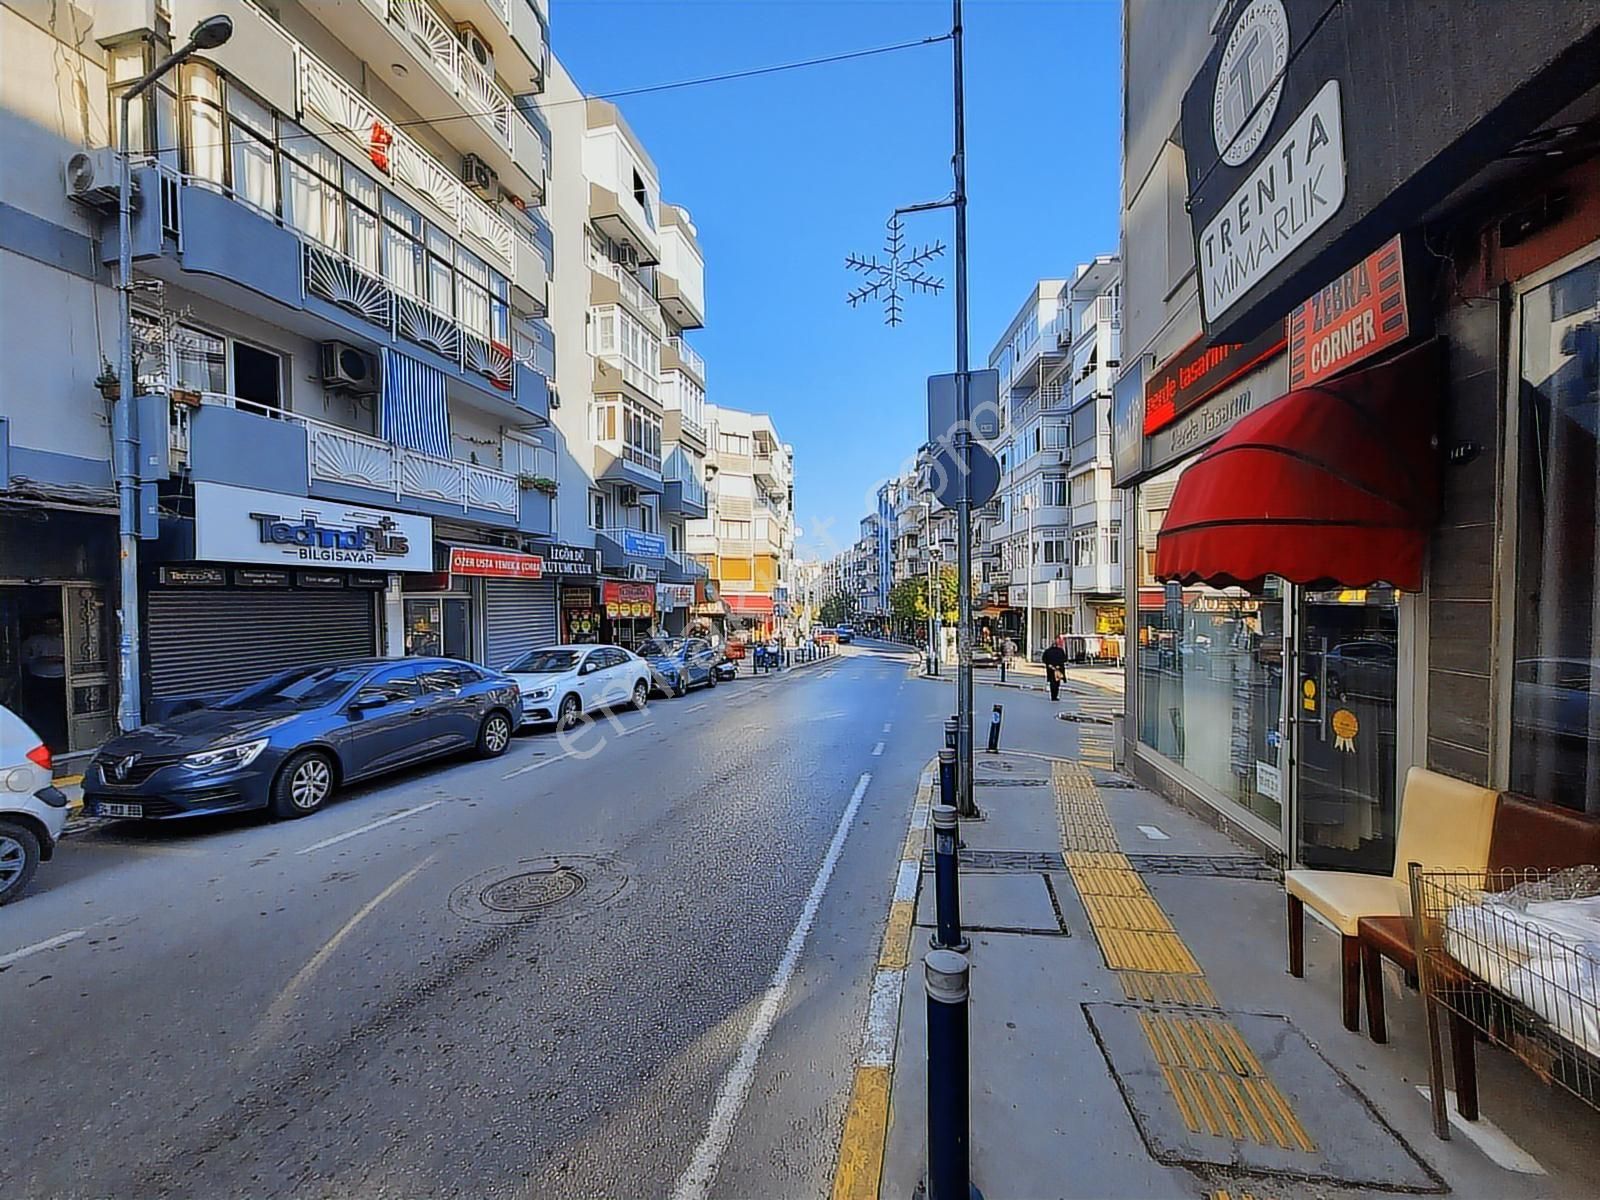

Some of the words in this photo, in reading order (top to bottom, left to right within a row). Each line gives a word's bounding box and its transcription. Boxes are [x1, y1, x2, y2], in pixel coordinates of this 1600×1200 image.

[1205, 112, 1330, 268] TRENTA
[1213, 163, 1328, 308] MİMARLIK
[1311, 259, 1373, 335] ZEBRA
[1310, 308, 1376, 374] CORNER
[299, 548, 374, 563] BİLGİSAYAR
